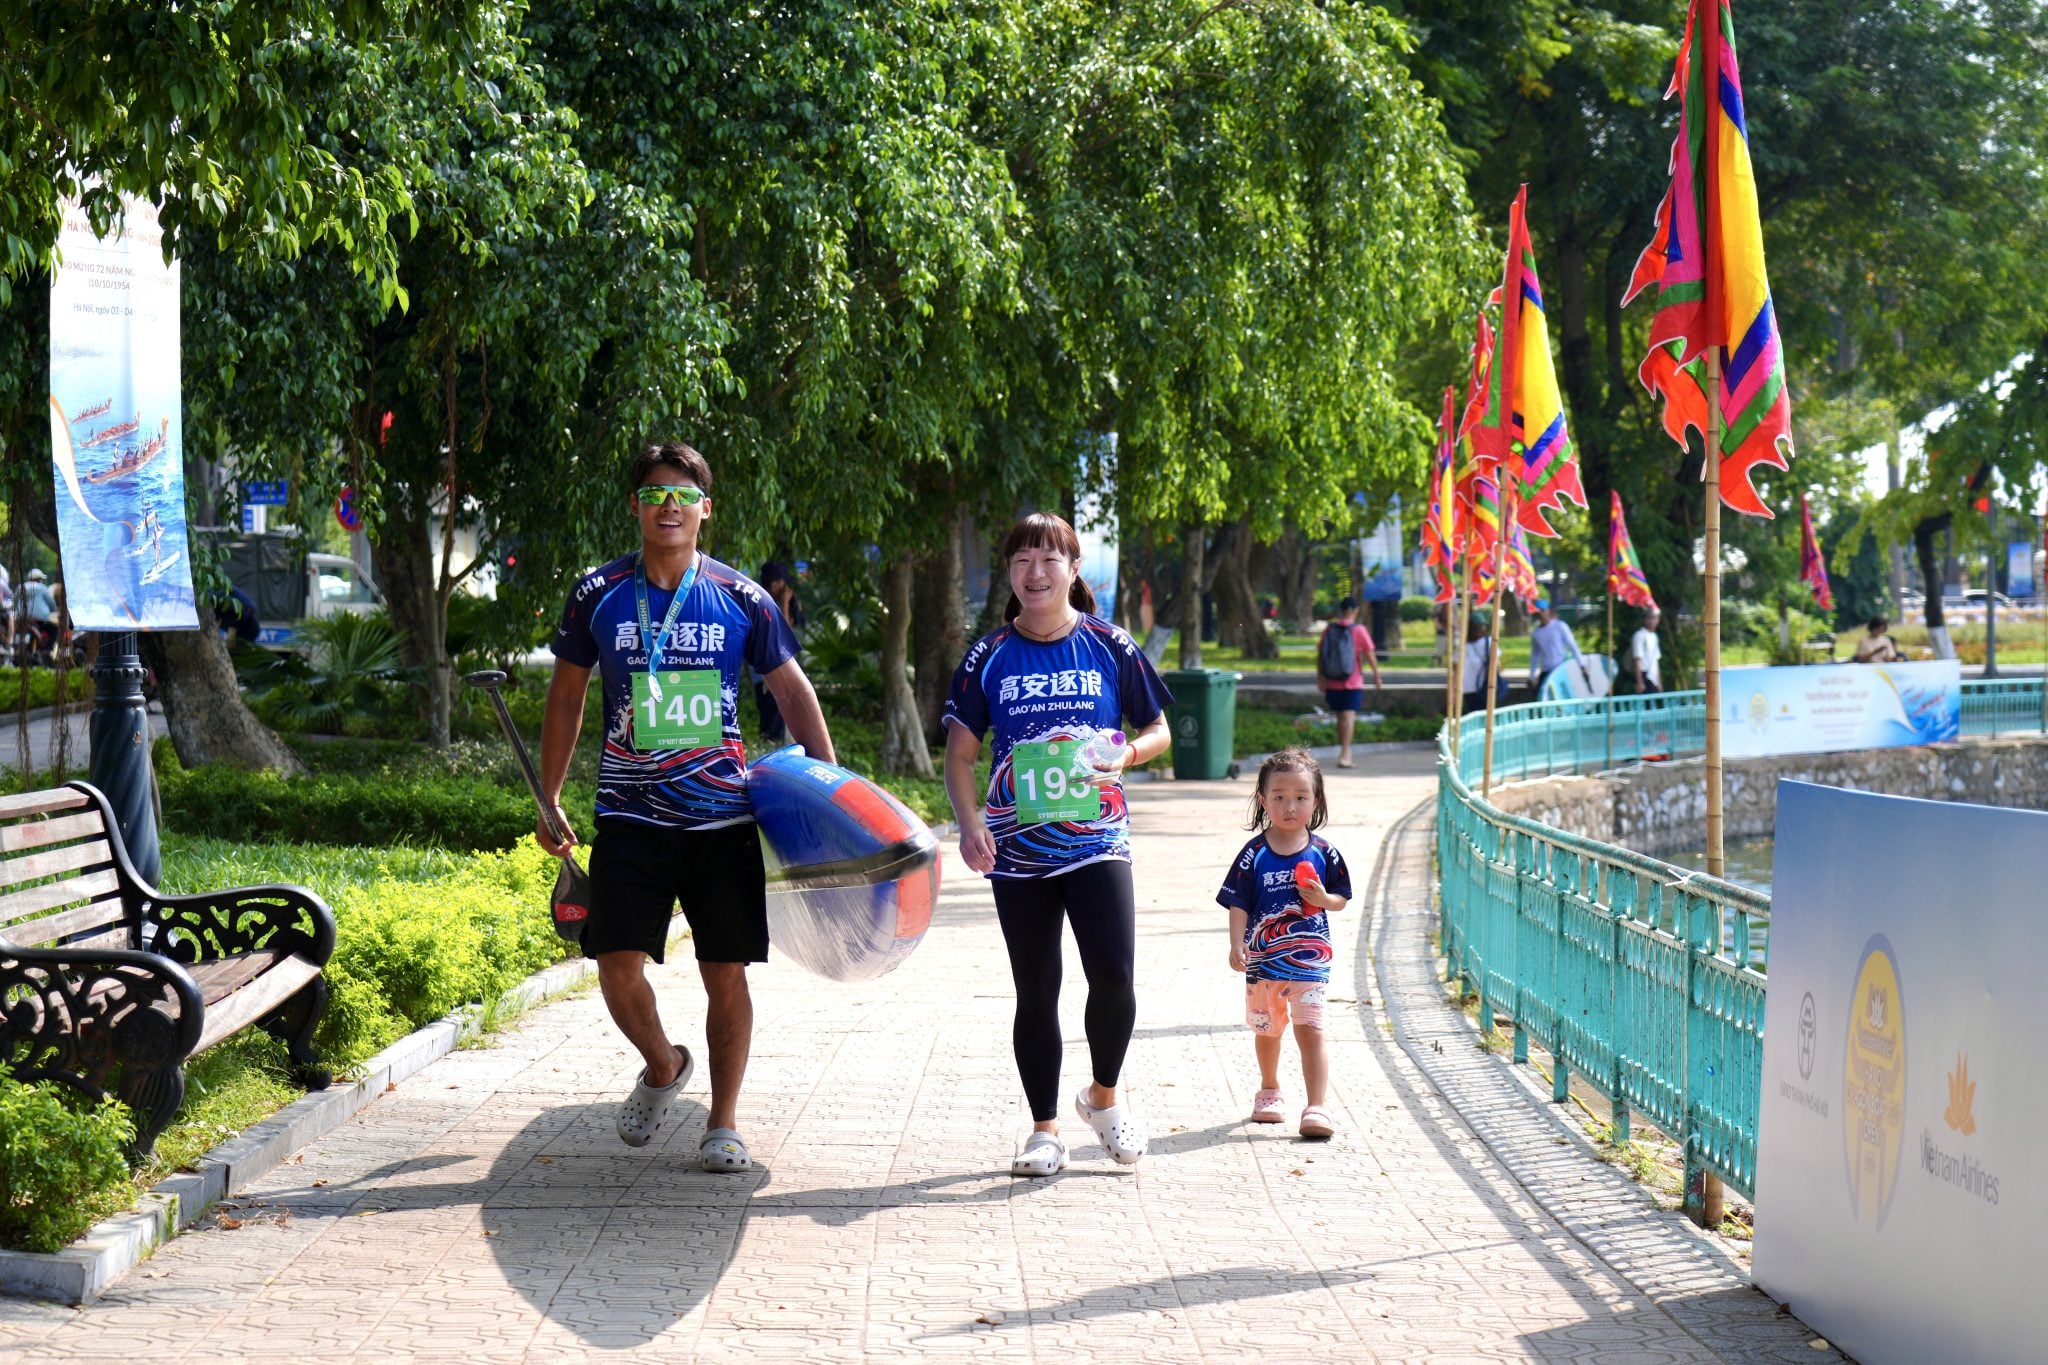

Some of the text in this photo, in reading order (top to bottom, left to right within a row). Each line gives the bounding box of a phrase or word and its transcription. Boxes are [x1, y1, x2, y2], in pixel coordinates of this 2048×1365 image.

[96, 265, 105, 274] 72
[110, 306, 120, 316] 03
[124, 307, 134, 317] 04
[735, 579, 762, 604] TPE
[639, 598, 649, 632] FINISHER
[663, 600, 681, 633] FINISHER
[1110, 628, 1136, 656] TPE
[668, 655, 715, 666] ZHULANG
[999, 669, 1103, 705] 高安逐浪
[641, 694, 712, 728] 140
[1008, 700, 1095, 716] GAO'AN ZHULANG
[1020, 766, 1091, 801] 193
[1326, 843, 1340, 865] TPE
[1920, 1127, 1960, 1186] Vietnam
[1959, 1153, 2000, 1206] Airlines
